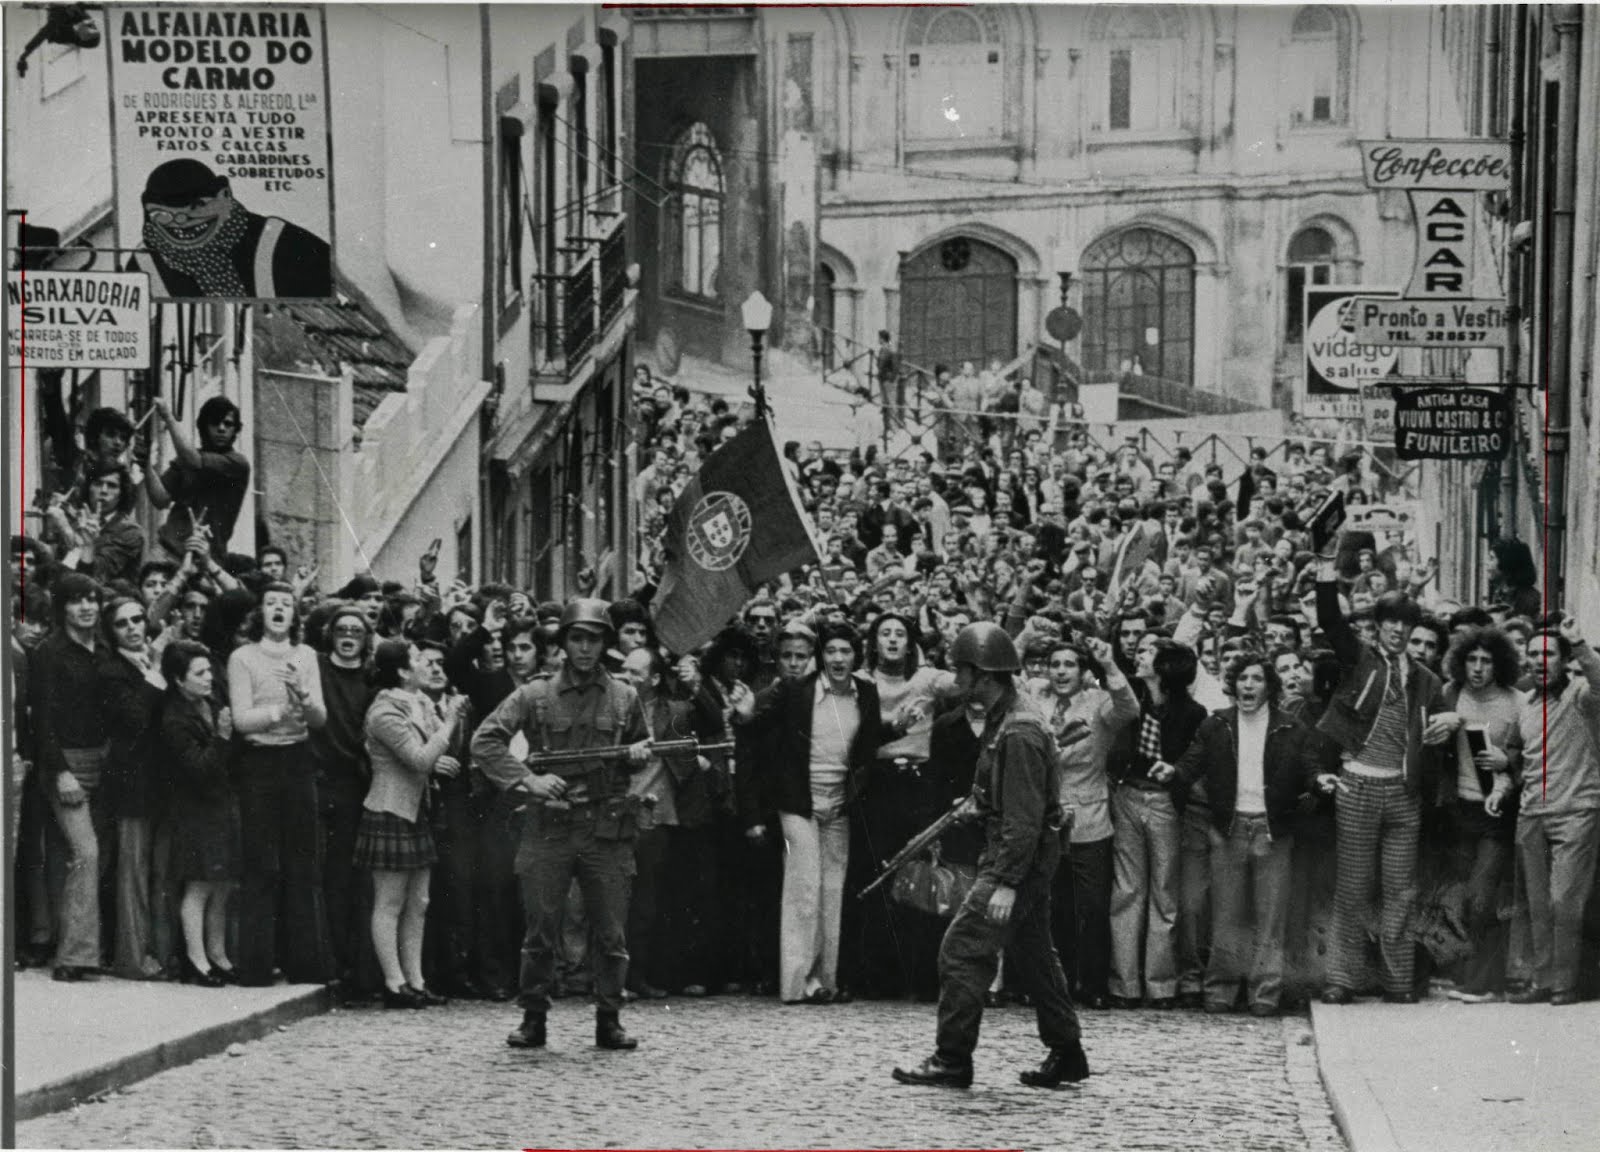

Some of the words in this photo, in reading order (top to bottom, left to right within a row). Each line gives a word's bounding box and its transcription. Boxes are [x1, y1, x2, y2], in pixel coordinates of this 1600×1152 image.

[121, 11, 312, 38] ALFAIATARIA
[121, 39, 252, 64] MODELO
[266, 40, 313, 64] DO
[162, 67, 275, 90] CARMO
[123, 94, 138, 109] DE
[144, 93, 217, 110] RODRIGUES
[223, 94, 233, 110] &
[135, 111, 237, 124] APRESENTA
[247, 112, 296, 125] TUDO
[139, 126, 214, 139] PRONTO
[221, 126, 233, 139] A
[242, 126, 305, 140] VESTIR
[215, 154, 311, 166] GABARDINES
[228, 167, 325, 180] SOBRETUDOS
[1424, 197, 1467, 292] ACAR
[22, 307, 118, 326] SILVA
[1364, 304, 1428, 328] Pronto
[1435, 312, 1446, 328] a
[87, 330, 99, 343] DE
[105, 330, 139, 344] TODOS
[69, 350, 84, 361] EM
[1313, 336, 1393, 362] vidago
[1325, 363, 1380, 378] salus
[1417, 393, 1456, 409] ANTIGA
[1460, 393, 1489, 409] CASA
[1436, 410, 1480, 429] CASTRO
[1482, 410, 1492, 429] &
[1404, 431, 1501, 454] FUNILEIRO
